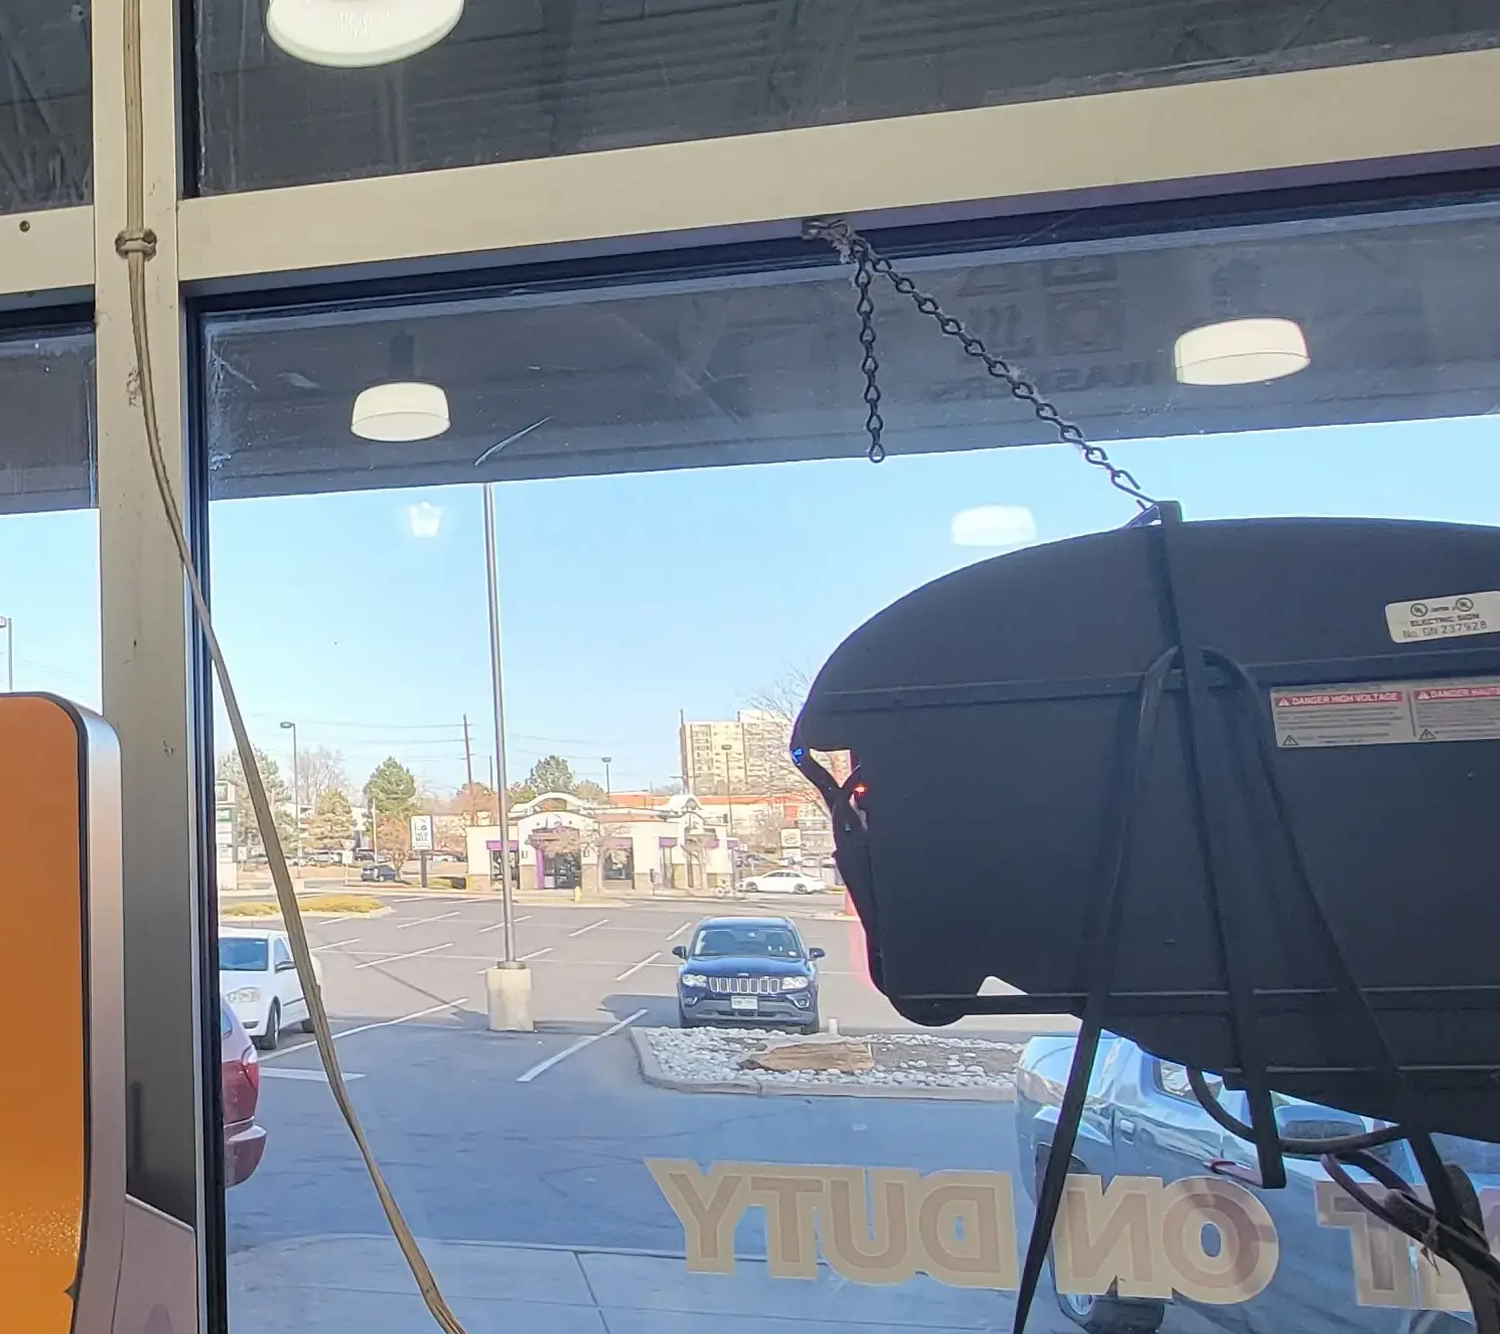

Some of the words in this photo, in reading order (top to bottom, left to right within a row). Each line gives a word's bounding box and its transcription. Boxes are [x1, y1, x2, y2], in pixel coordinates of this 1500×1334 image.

[1292, 696, 1331, 706] DANGER
[1331, 694, 1353, 704] HIGH
[1354, 692, 1399, 703] VOLTAGE
